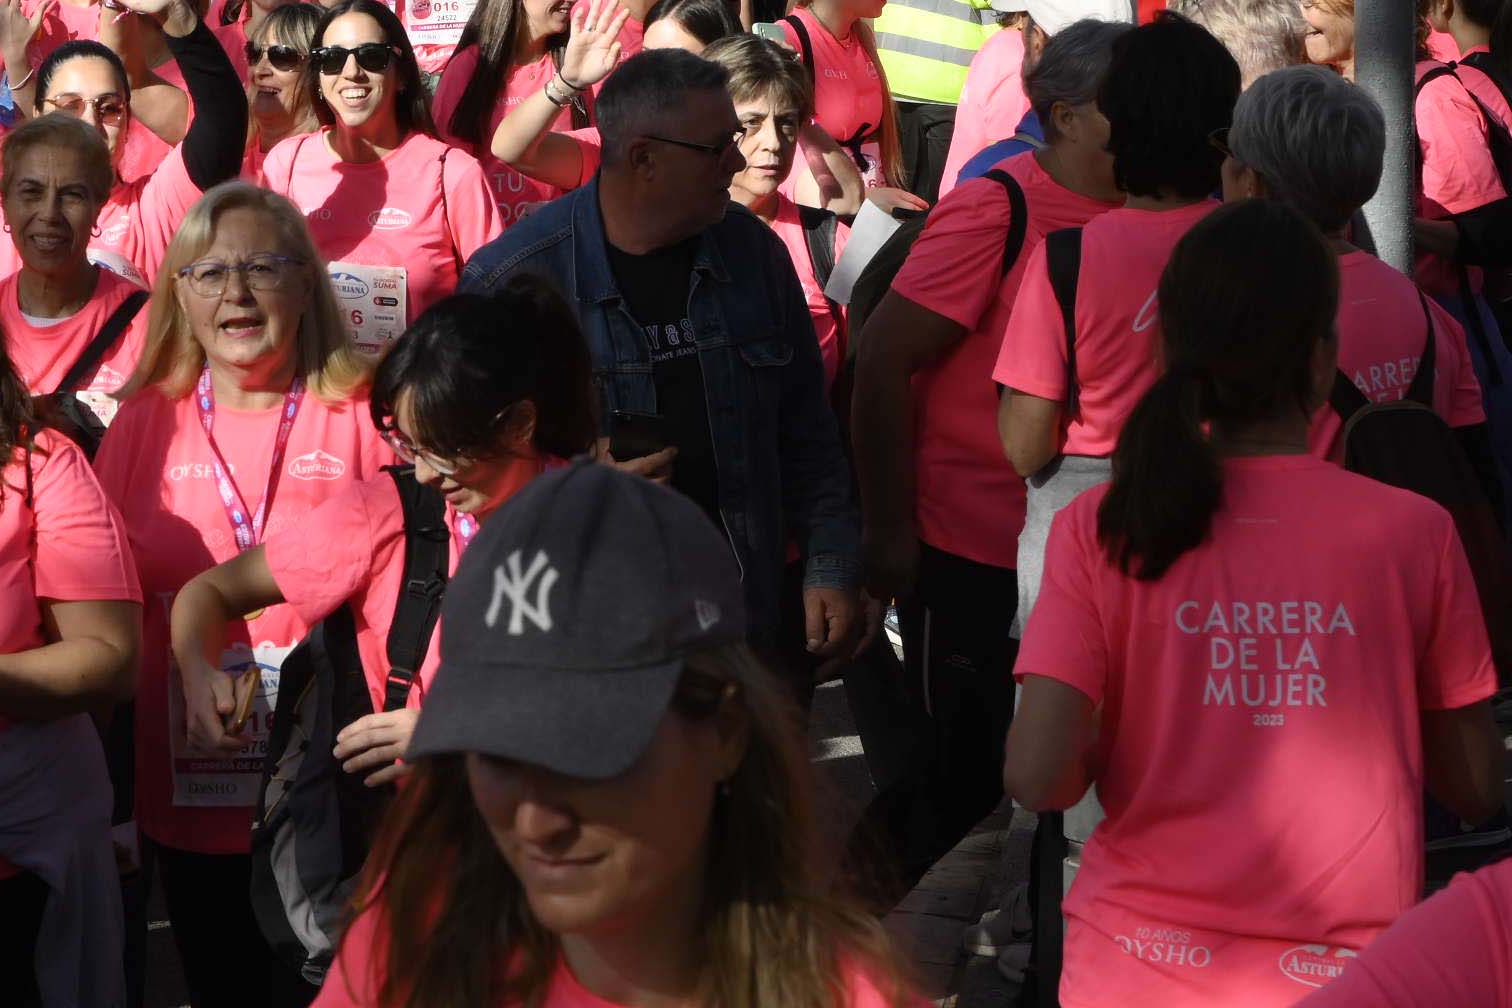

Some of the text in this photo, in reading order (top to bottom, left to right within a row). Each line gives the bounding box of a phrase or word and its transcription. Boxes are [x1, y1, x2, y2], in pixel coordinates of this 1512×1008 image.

[433, 2, 459, 13] 016
[493, 173, 525, 192] TU
[484, 549, 560, 636] NY
[1175, 600, 1356, 636] CARRERA
[1210, 637, 1320, 670] DE LA
[1203, 673, 1327, 708] MUJER
